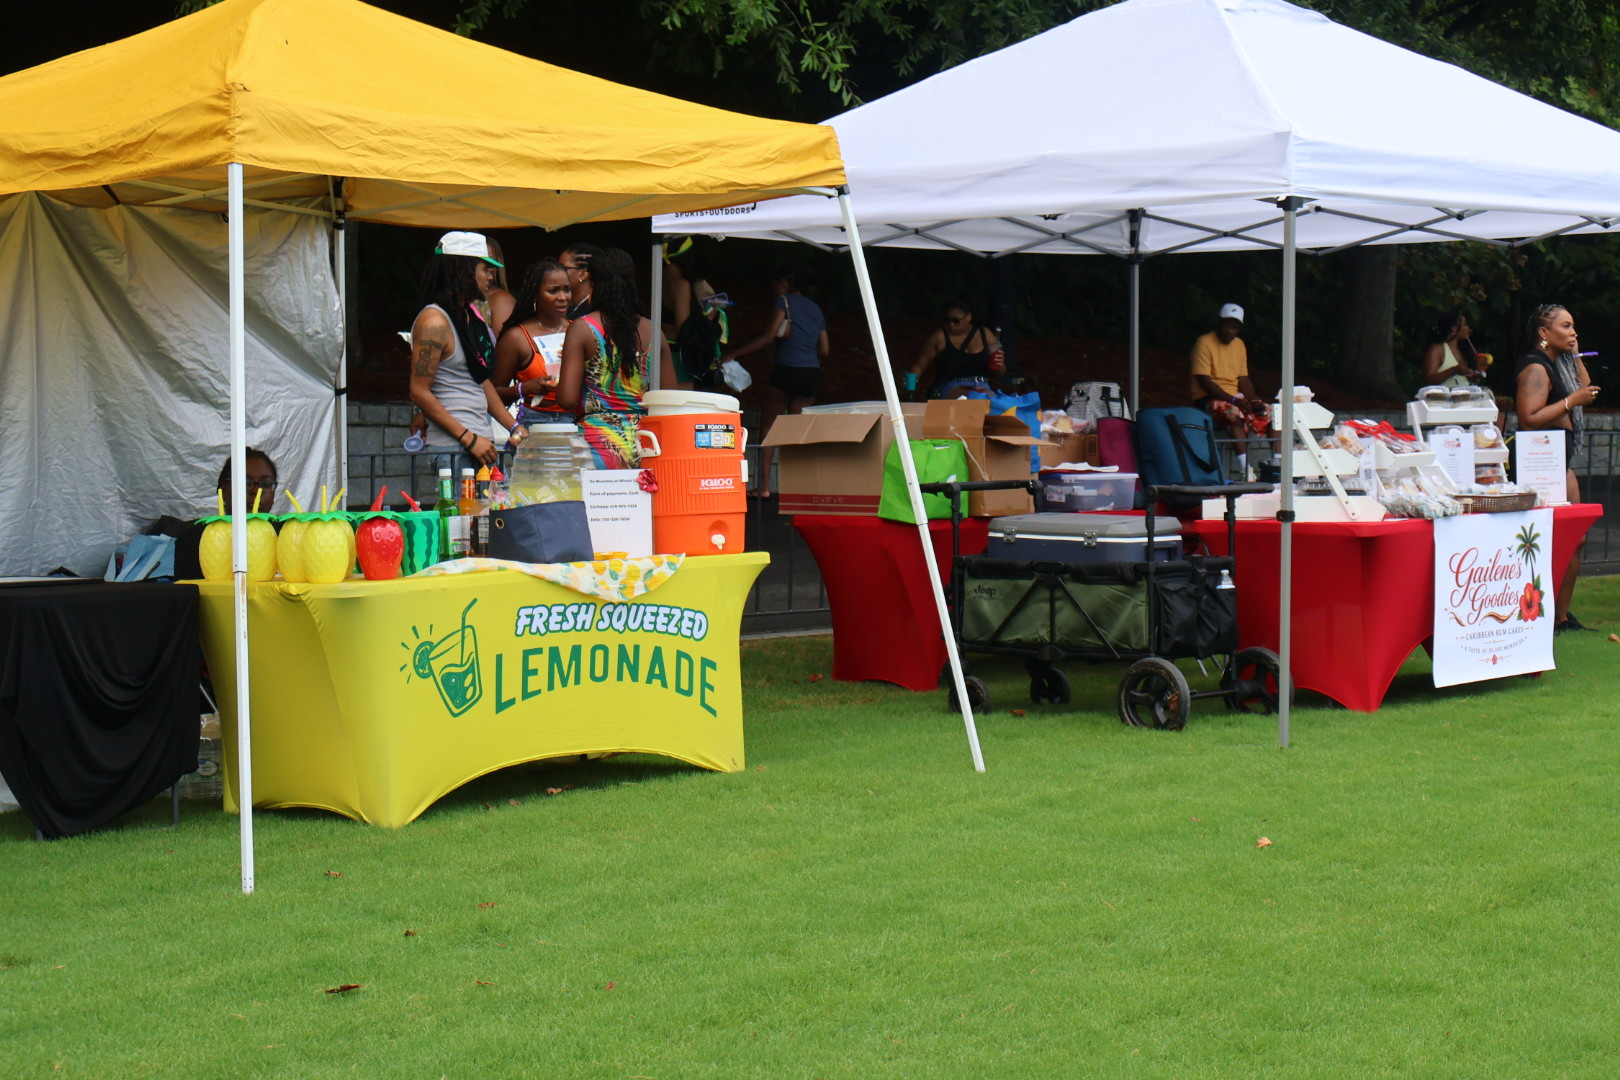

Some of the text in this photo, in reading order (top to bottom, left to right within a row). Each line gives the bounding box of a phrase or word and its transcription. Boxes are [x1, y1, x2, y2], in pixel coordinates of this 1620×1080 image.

[701, 478, 733, 487] IGLOO
[974, 584, 996, 596] Jeep
[1449, 547, 1522, 608] Gailene's
[515, 601, 709, 641] FRESH SQUEEZED
[1467, 583, 1519, 625] Goodies
[1465, 626, 1524, 641] CARIBBEAN RUM CAKES
[495, 643, 718, 719] LEMONADE
